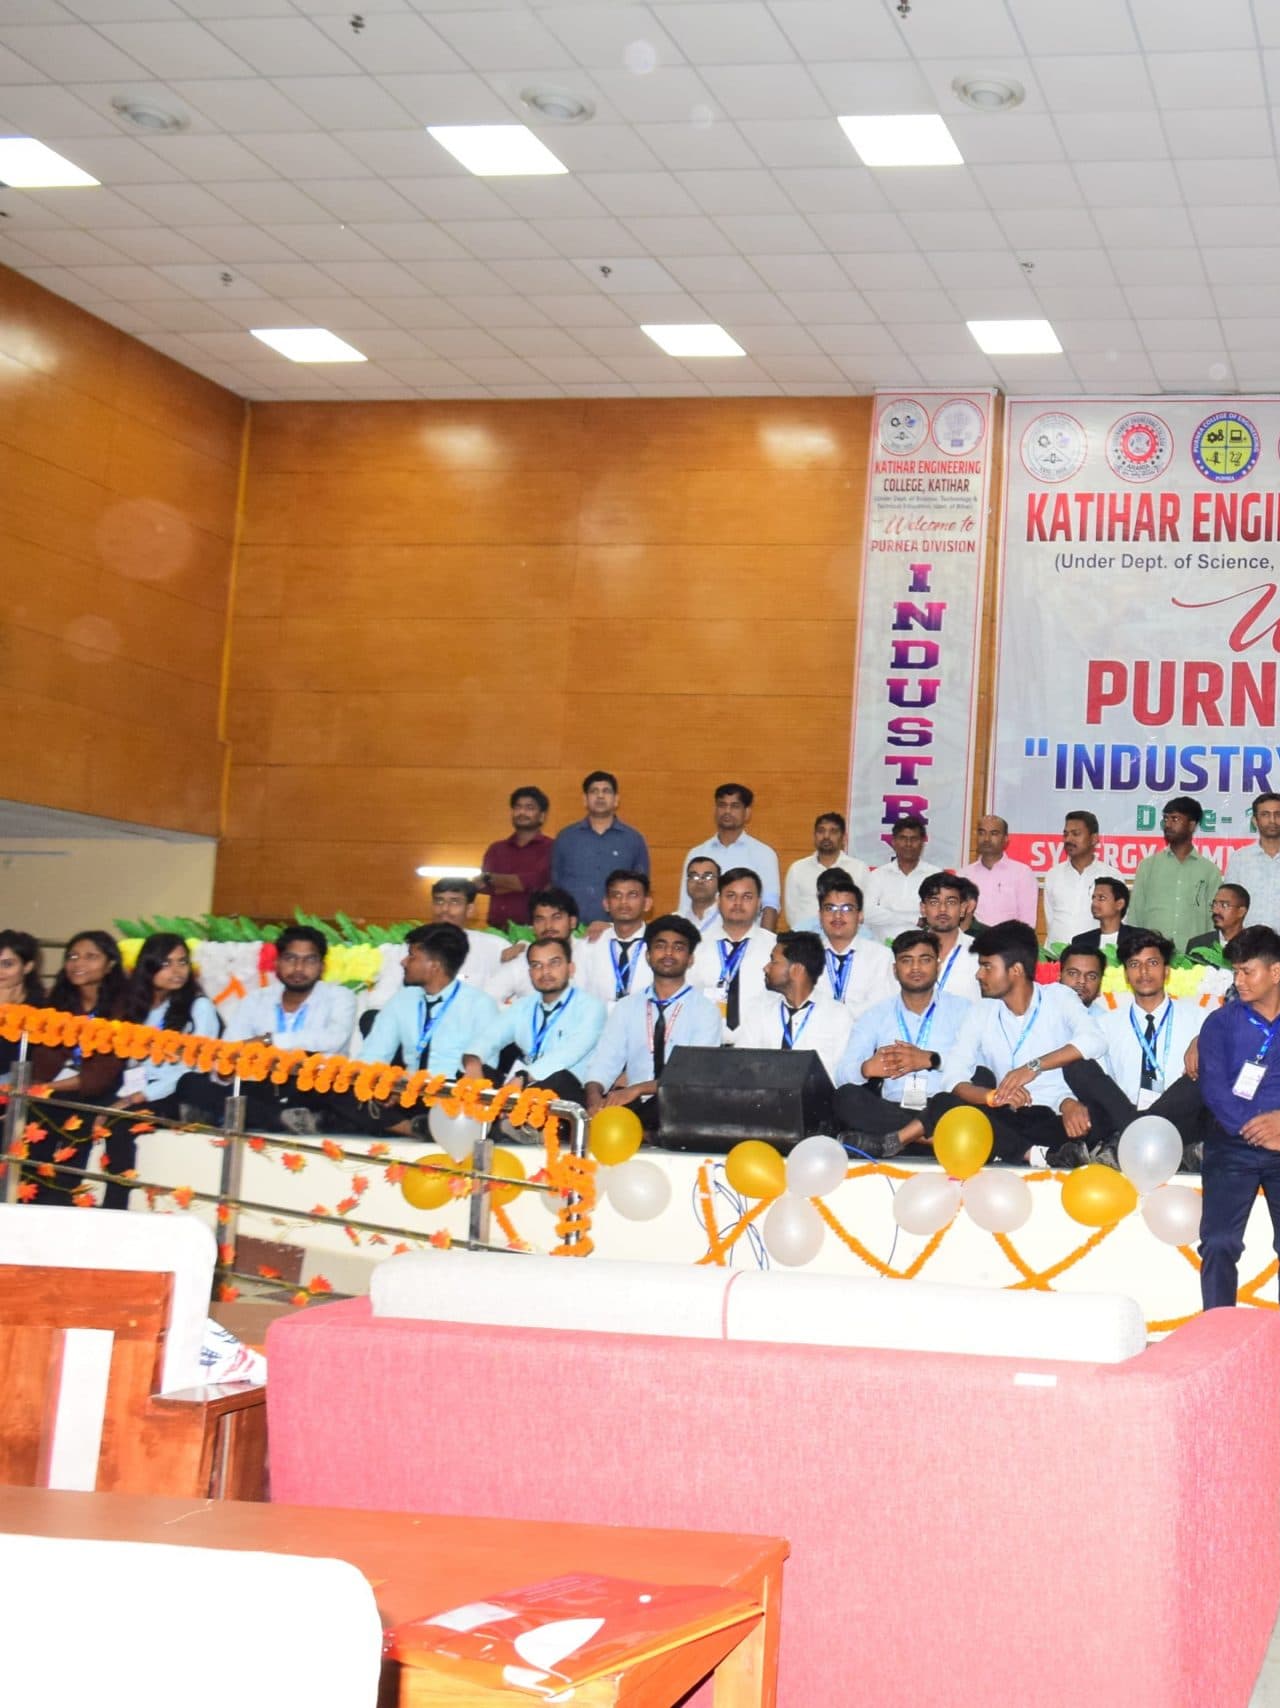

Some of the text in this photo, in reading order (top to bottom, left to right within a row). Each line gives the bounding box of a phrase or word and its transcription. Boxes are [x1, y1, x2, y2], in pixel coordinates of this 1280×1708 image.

[874, 460, 981, 474] KATIHAR ENGINEERING
[883, 478, 970, 494] COLLEGE, KATIHAR
[1026, 492, 1181, 542] KATIHAR
[871, 540, 976, 553] PURNEA DIVISION
[1055, 553, 1114, 573] (Under
[1121, 554, 1168, 573] Dept.
[1175, 553, 1192, 570] of
[1198, 554, 1275, 573] Science,
[880, 563, 947, 862] INDUSTR
